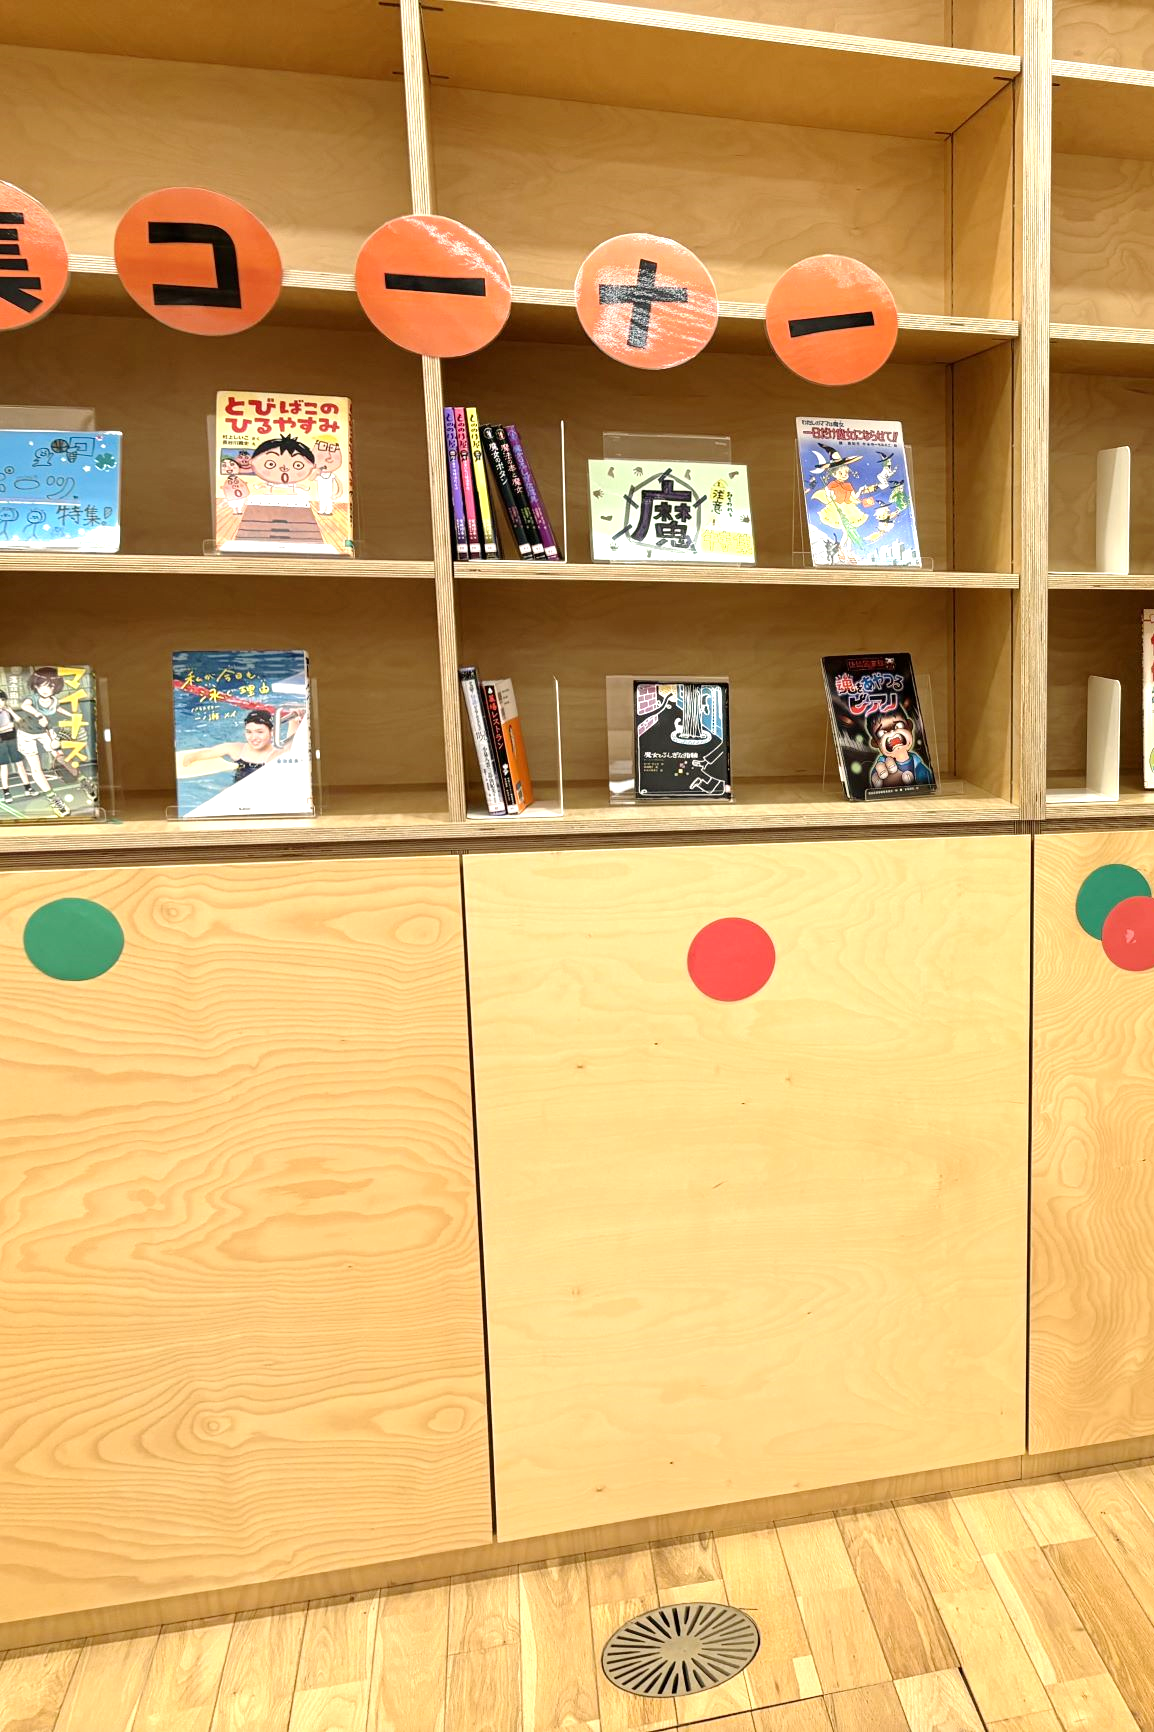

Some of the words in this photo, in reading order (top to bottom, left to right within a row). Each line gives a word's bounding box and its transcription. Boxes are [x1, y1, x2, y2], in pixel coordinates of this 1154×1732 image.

[225, 397, 339, 416] とびばこの
[225, 417, 340, 435] ひるやすみ
